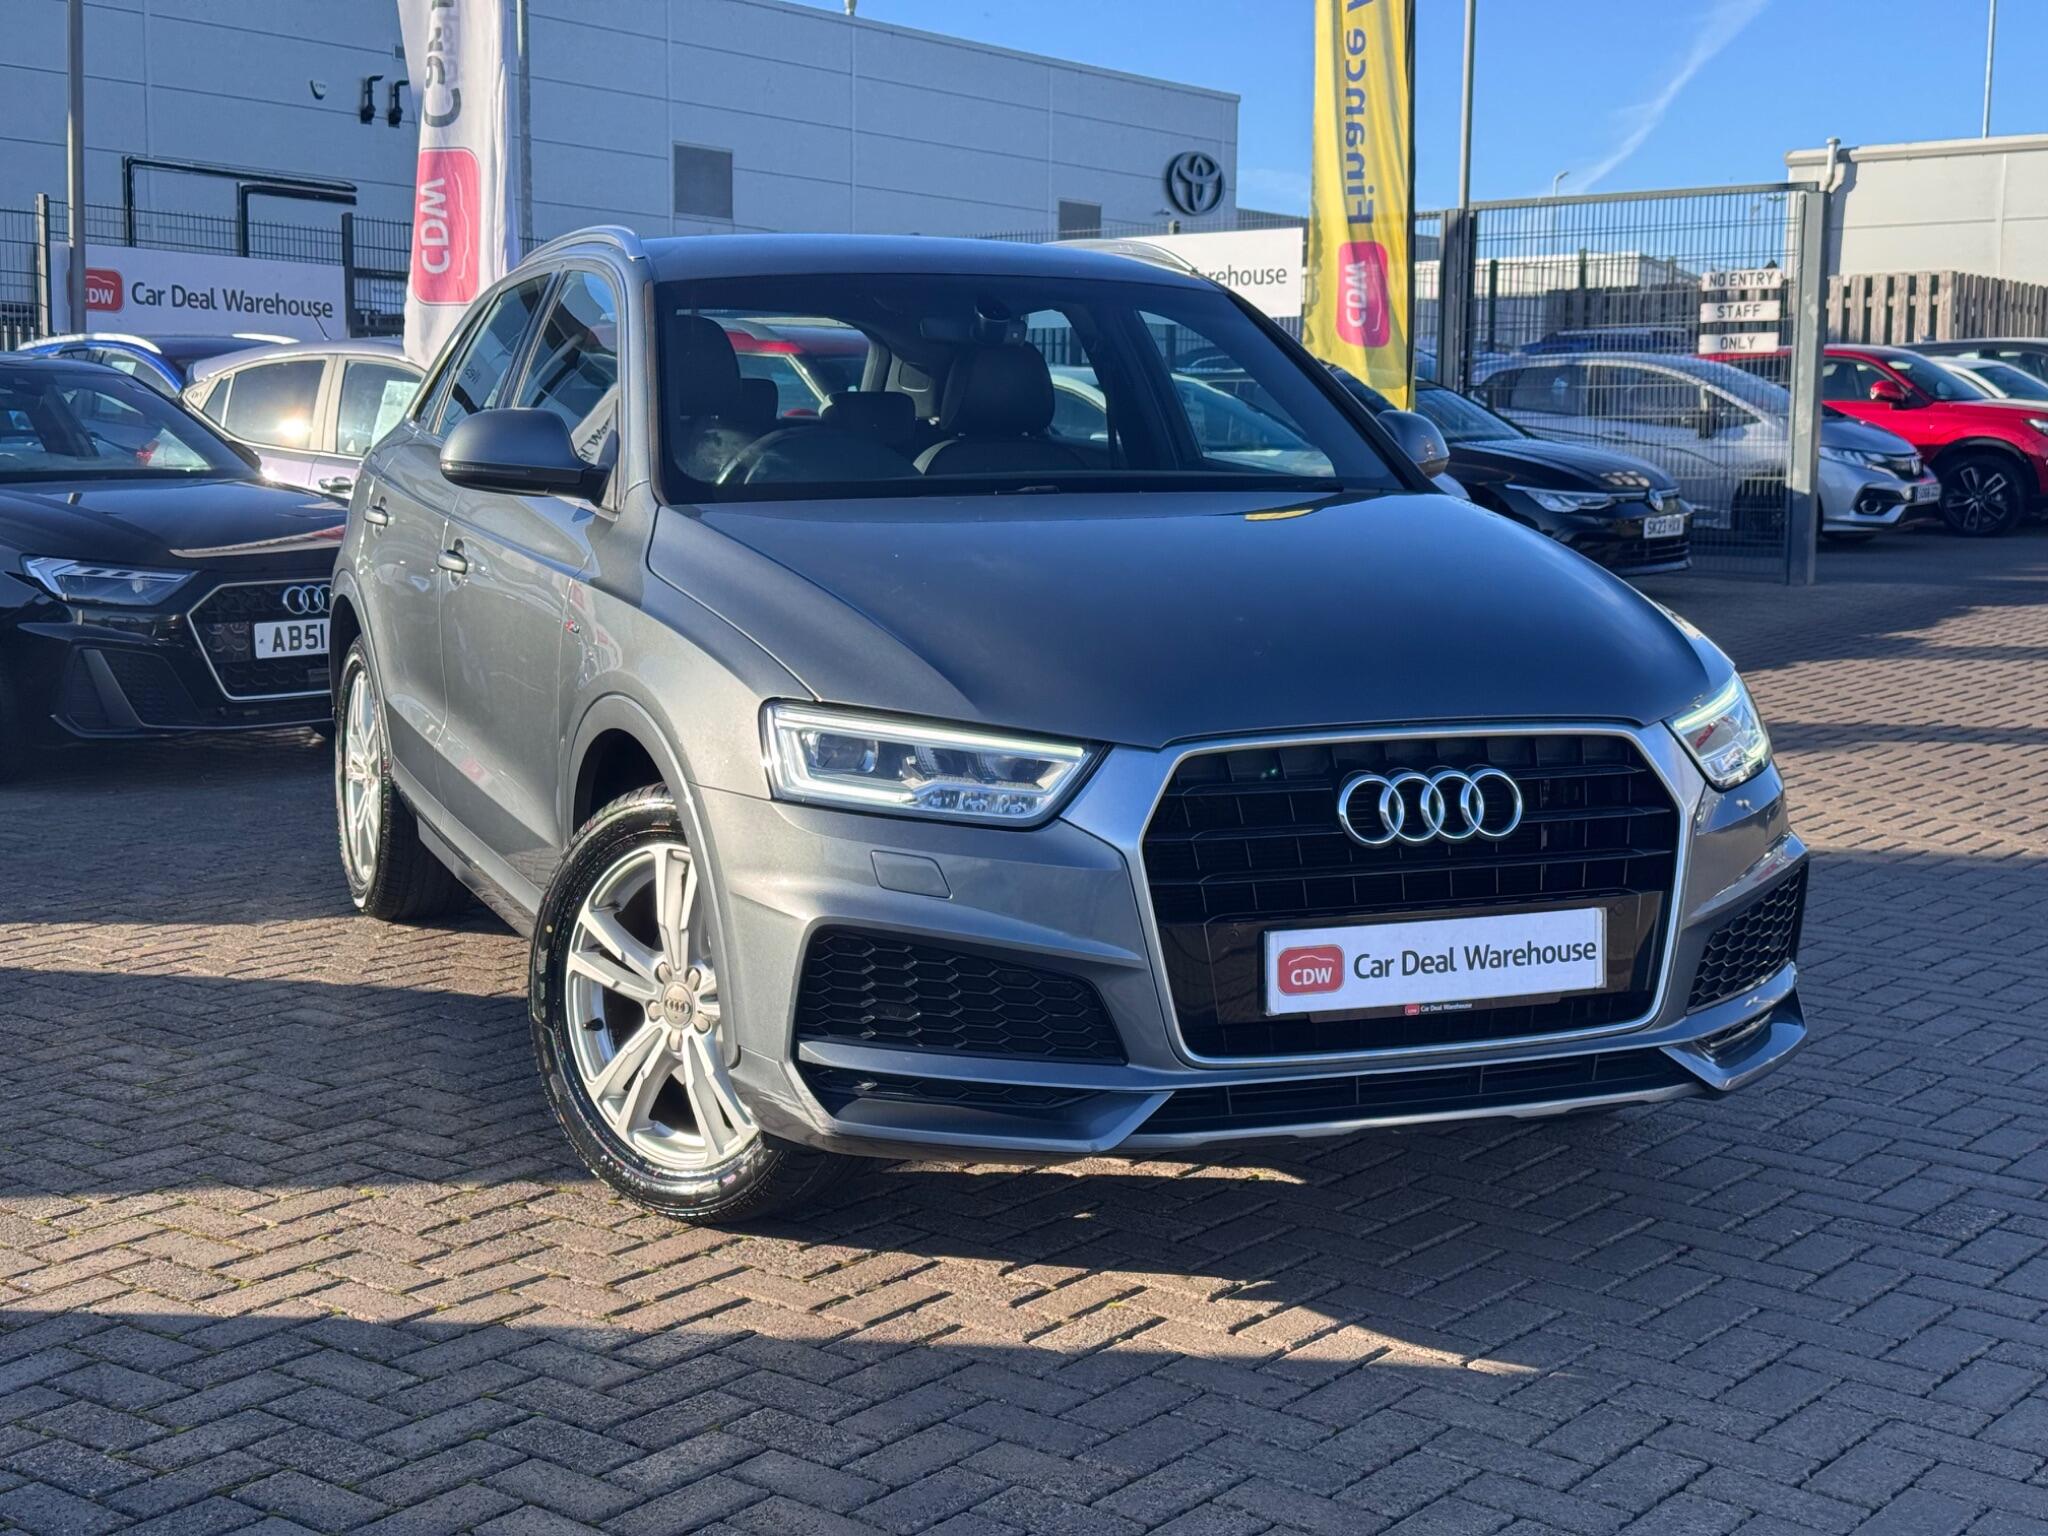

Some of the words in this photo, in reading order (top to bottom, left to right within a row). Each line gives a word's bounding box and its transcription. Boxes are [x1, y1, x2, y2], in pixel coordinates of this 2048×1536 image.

[1207, 264, 1287, 287] rehouse
[1708, 273, 1726, 288] NO
[1729, 271, 1774, 287] ENTRY
[86, 287, 114, 304] DW
[131, 281, 166, 306] Car
[172, 284, 218, 311] Deal
[222, 288, 334, 319] Warehouse
[1717, 303, 1762, 318] STAFF
[1720, 336, 1755, 350] ONLY
[1290, 965, 1333, 986] CDW
[1353, 952, 1395, 979] Car
[1401, 947, 1457, 977] Deal
[1463, 940, 1597, 971] Warehouse
